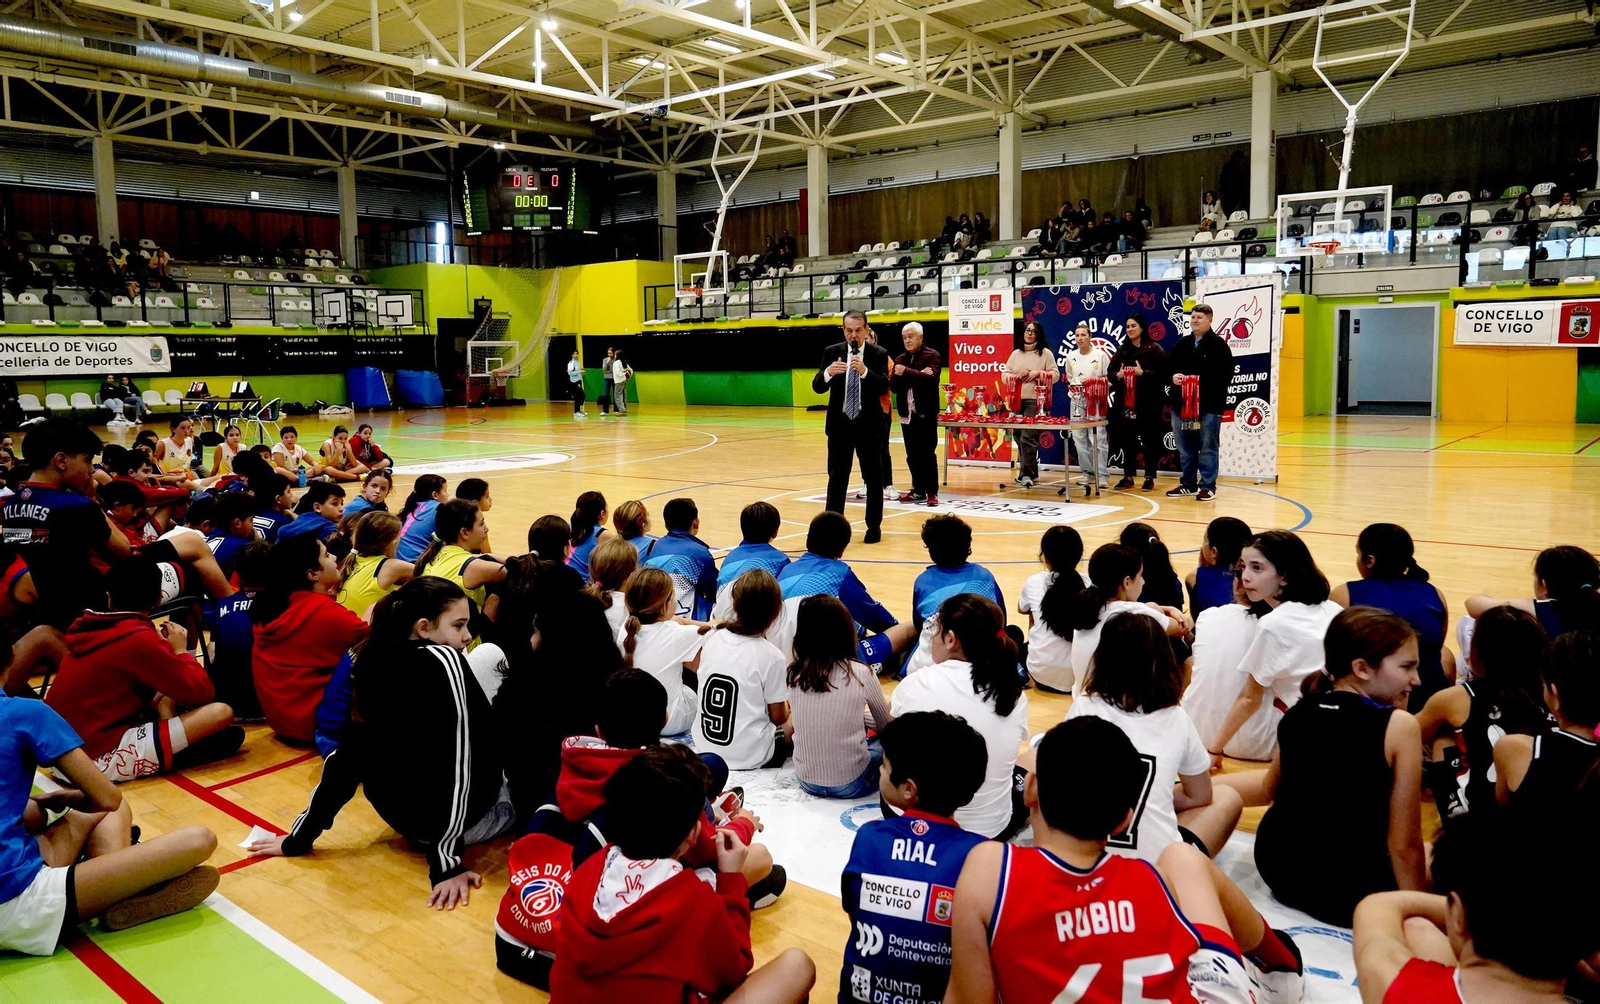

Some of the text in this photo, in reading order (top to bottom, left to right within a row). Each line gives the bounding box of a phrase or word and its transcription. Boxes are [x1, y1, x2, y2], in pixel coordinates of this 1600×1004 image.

[513, 174, 559, 187] 0 E 0
[515, 195, 548, 207] 00:00
[1465, 310, 1544, 320] CONCELLO
[972, 318, 1002, 331] vide
[1473, 322, 1533, 333] DE VIGO
[65, 342, 81, 352] DE
[85, 342, 117, 352] VIGO
[954, 342, 995, 355] Vive o
[54, 356, 70, 367] de
[75, 356, 133, 368] Deportes
[954, 360, 1006, 375] deporte
[1255, 372, 1268, 382] NO
[1236, 404, 1247, 418] SEIS
[1255, 400, 1271, 418] NADAL
[1252, 415, 1258, 424] 6
[3, 503, 50, 521] YLLANES
[701, 673, 739, 746] 9
[891, 838, 937, 867] RIAL
[510, 865, 540, 887] SEIS
[543, 862, 562, 877] DO
[865, 881, 921, 899] CONCELLO
[869, 893, 912, 910] DE VIGO
[1055, 900, 1136, 942] RUBIO
[875, 975, 921, 997] XUNTA
[874, 990, 891, 1004] DE
